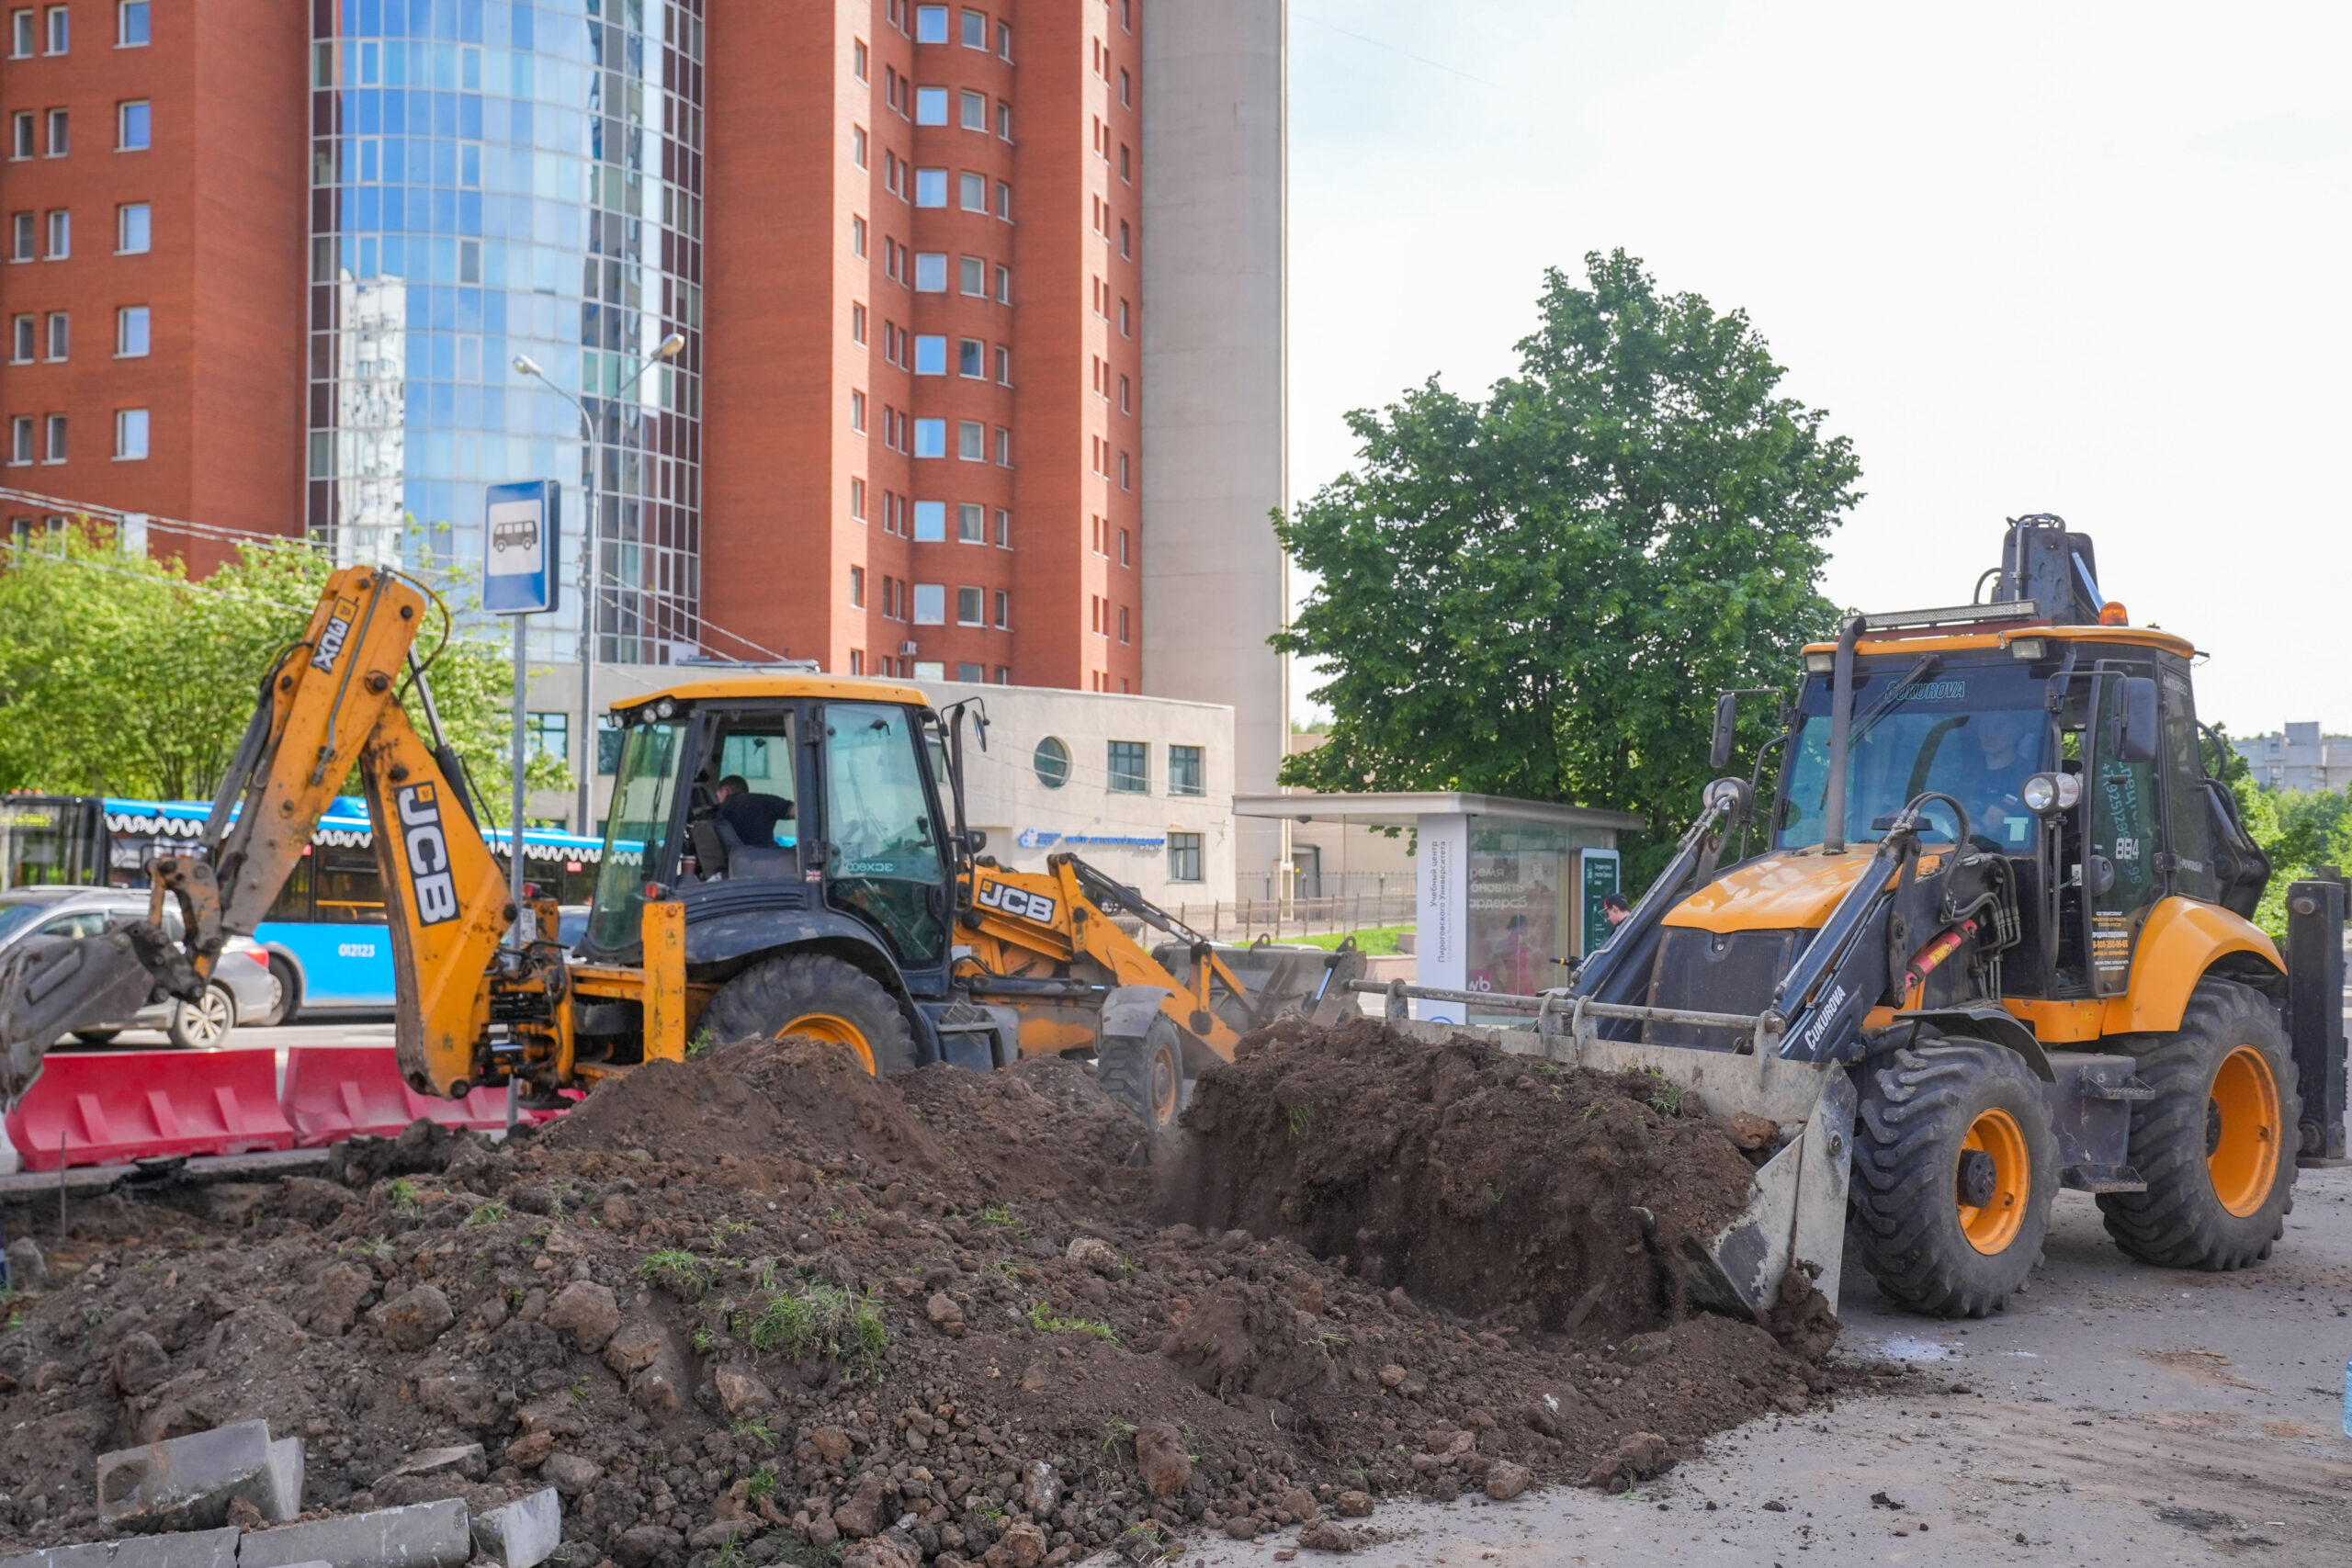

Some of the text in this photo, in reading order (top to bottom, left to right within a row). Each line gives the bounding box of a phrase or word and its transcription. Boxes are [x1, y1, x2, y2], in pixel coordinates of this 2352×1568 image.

[399, 787, 457, 923] JCB
[2116, 838, 2139, 860] 884
[1430, 869, 1438, 907] Учебный
[1469, 867, 1505, 880] ремя
[1470, 881, 1525, 894] бновить
[979, 884, 1053, 922] JCB
[1438, 840, 1447, 963] Пироговского Университета
[1469, 896, 1528, 910] ардероб
[1804, 985, 1846, 1052] ÇUKUROVA
